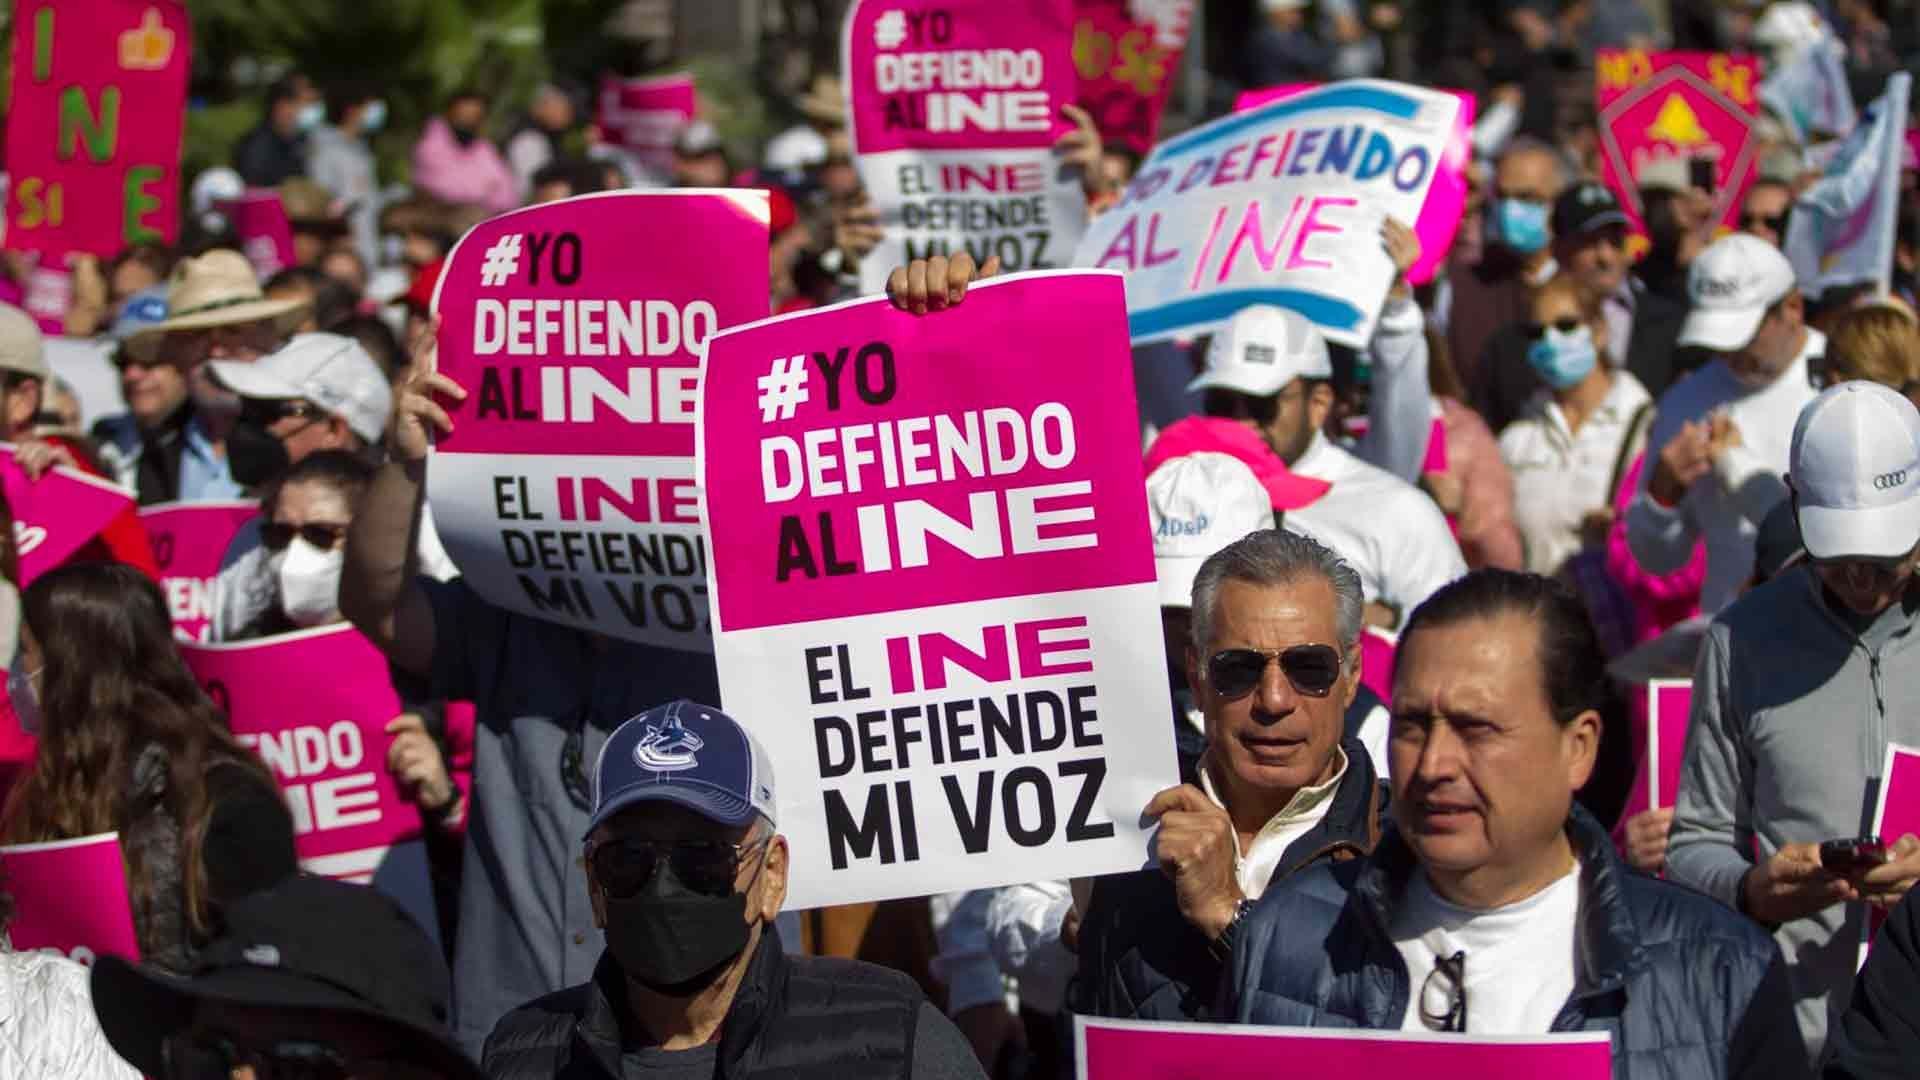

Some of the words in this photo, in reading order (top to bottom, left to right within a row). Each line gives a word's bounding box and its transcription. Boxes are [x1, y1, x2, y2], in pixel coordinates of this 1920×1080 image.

[875, 49, 1043, 93] DEFIENDO
[899, 164, 931, 194] EL
[940, 162, 1042, 193] INE
[1176, 124, 1429, 194] DEFIENDO
[902, 194, 1049, 231] DEFIENDE
[480, 232, 582, 287] #YO
[964, 232, 1055, 273] VOZ
[1095, 213, 1179, 272] AL
[1191, 196, 1358, 291] INE
[473, 299, 718, 356] DEFIENDO
[757, 341, 897, 423] #YO
[760, 402, 1077, 504] DEFIENDO
[493, 476, 543, 520] EL
[556, 477, 701, 523] INE
[519, 574, 599, 620] MI
[804, 644, 871, 704] EL
[886, 616, 1093, 694] INE
[813, 685, 1103, 778] DEFIENDE
[822, 780, 920, 871] MI
[941, 757, 1114, 854] VOZ
